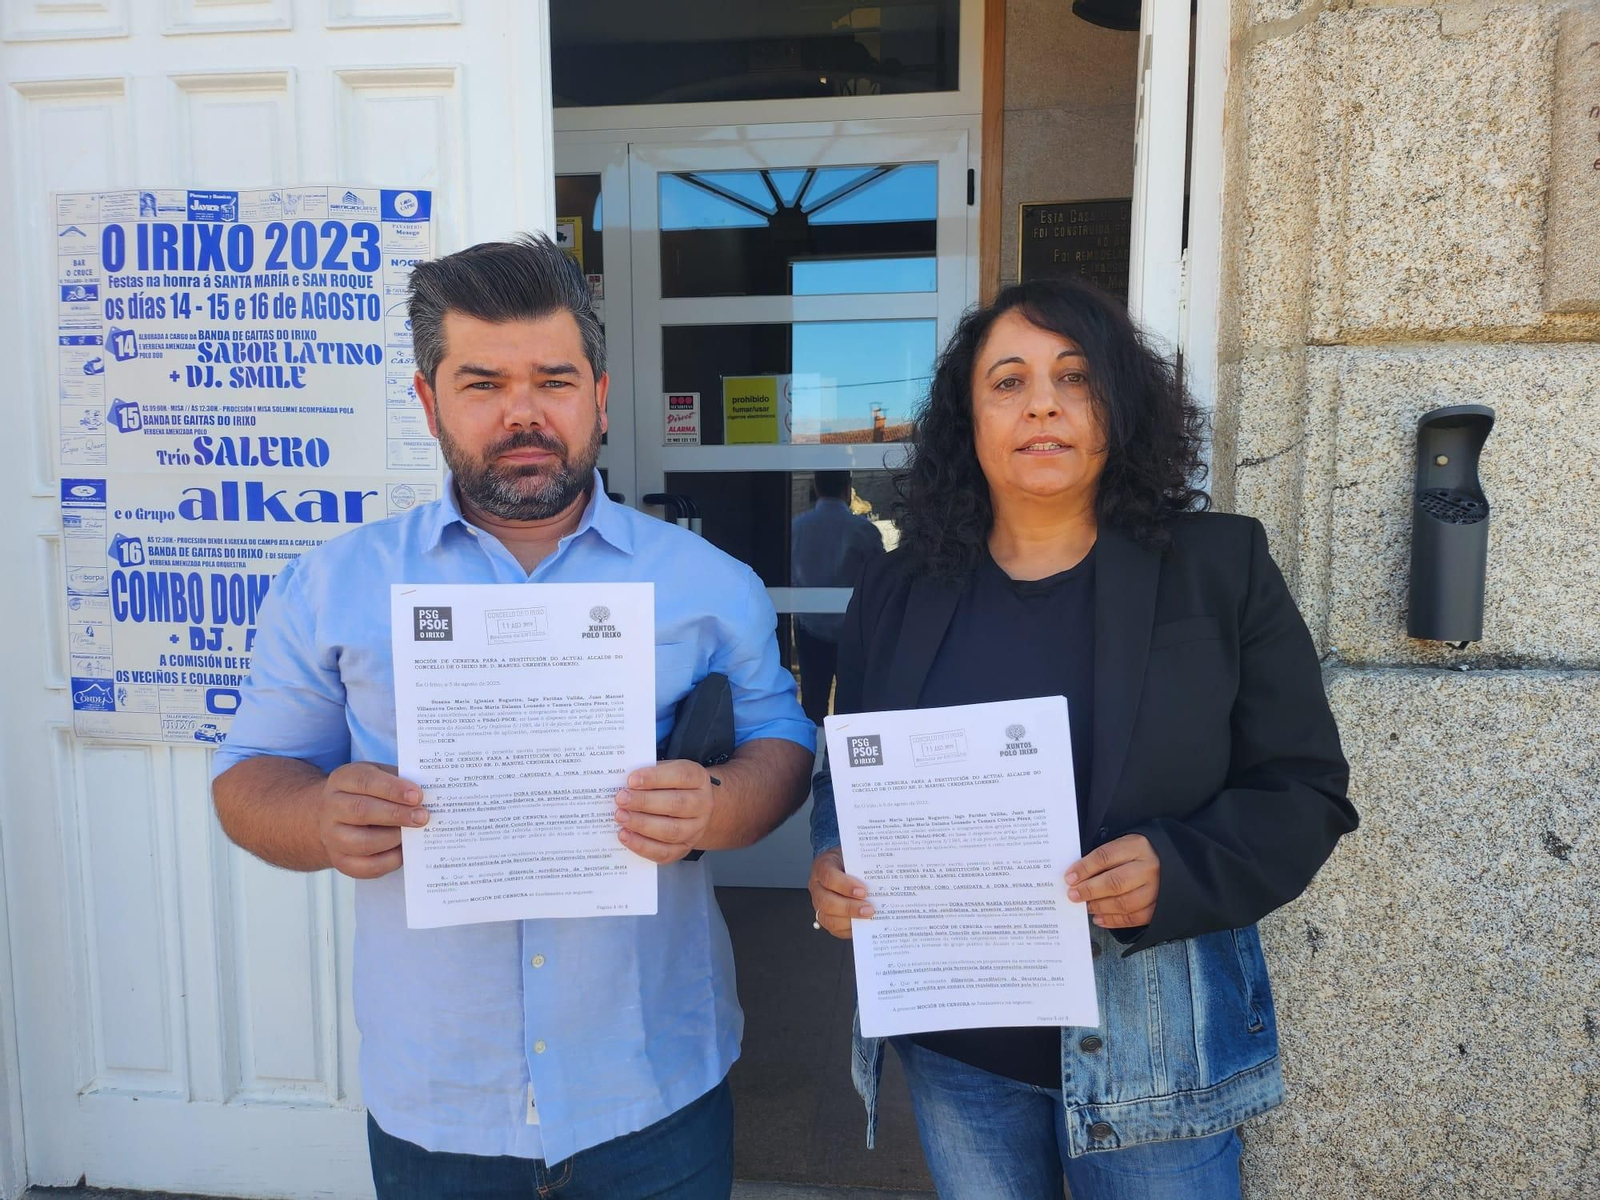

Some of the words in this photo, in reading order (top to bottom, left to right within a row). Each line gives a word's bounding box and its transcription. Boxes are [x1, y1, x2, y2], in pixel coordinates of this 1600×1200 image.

[102, 223, 126, 273] O
[137, 223, 254, 273] IRIXO
[265, 220, 382, 273] 2023
[108, 275, 144, 288] Festas
[146, 276, 160, 288] na
[164, 274, 200, 288] honra
[203, 274, 211, 288] á
[214, 275, 252, 288] SANTA
[254, 270, 289, 288] MARÍA
[292, 275, 300, 286] e
[302, 273, 327, 288] SAN
[330, 274, 374, 289] ROQUE
[105, 297, 124, 320] os
[128, 291, 166, 320] días
[170, 292, 191, 319] 14
[207, 292, 230, 320] 15
[234, 298, 246, 320] e
[250, 292, 268, 320] 16
[273, 292, 296, 320] de
[301, 292, 380, 322] AGOSTO
[198, 330, 230, 340] BANDA
[232, 330, 244, 340] DE
[245, 330, 274, 340] GAITAS
[276, 330, 288, 340] DO
[292, 330, 316, 340] IRIXO
[114, 334, 136, 357] 14
[197, 342, 278, 364] SABOR
[284, 342, 382, 366] LATINO
[186, 365, 222, 388] DJ.
[229, 366, 306, 388] SMILE
[732, 395, 770, 404] prohibido
[118, 406, 140, 430] 15
[299, 406, 338, 414] ACOMPAÑADA
[143, 415, 170, 426] BANDA
[172, 415, 181, 426] DE
[184, 415, 215, 426] GAITAS
[218, 416, 230, 426] DO
[233, 416, 256, 426] IRIXO
[156, 448, 190, 466] Trío
[193, 436, 330, 468] SALERO
[124, 510, 132, 520] o
[135, 507, 175, 523] Grupo
[178, 480, 378, 524] alkar
[120, 540, 143, 564] 16
[148, 546, 176, 556] BANDA
[179, 546, 190, 557] DE
[192, 547, 222, 558] GAITAS
[224, 548, 235, 558] DO
[238, 548, 263, 558] IRIXO
[112, 570, 204, 624] COMBO
[419, 610, 439, 619] PSG
[420, 620, 449, 630] PSOE
[189, 626, 233, 651] DJ.
[160, 655, 167, 666] A
[169, 654, 222, 668] COMISIÓN
[225, 657, 238, 668] DE
[240, 658, 252, 669] FE
[116, 670, 129, 682] OS
[132, 669, 178, 684] VECIÑOS
[181, 672, 186, 684] E
[852, 738, 869, 747] PSG
[853, 746, 879, 757] PSOE
